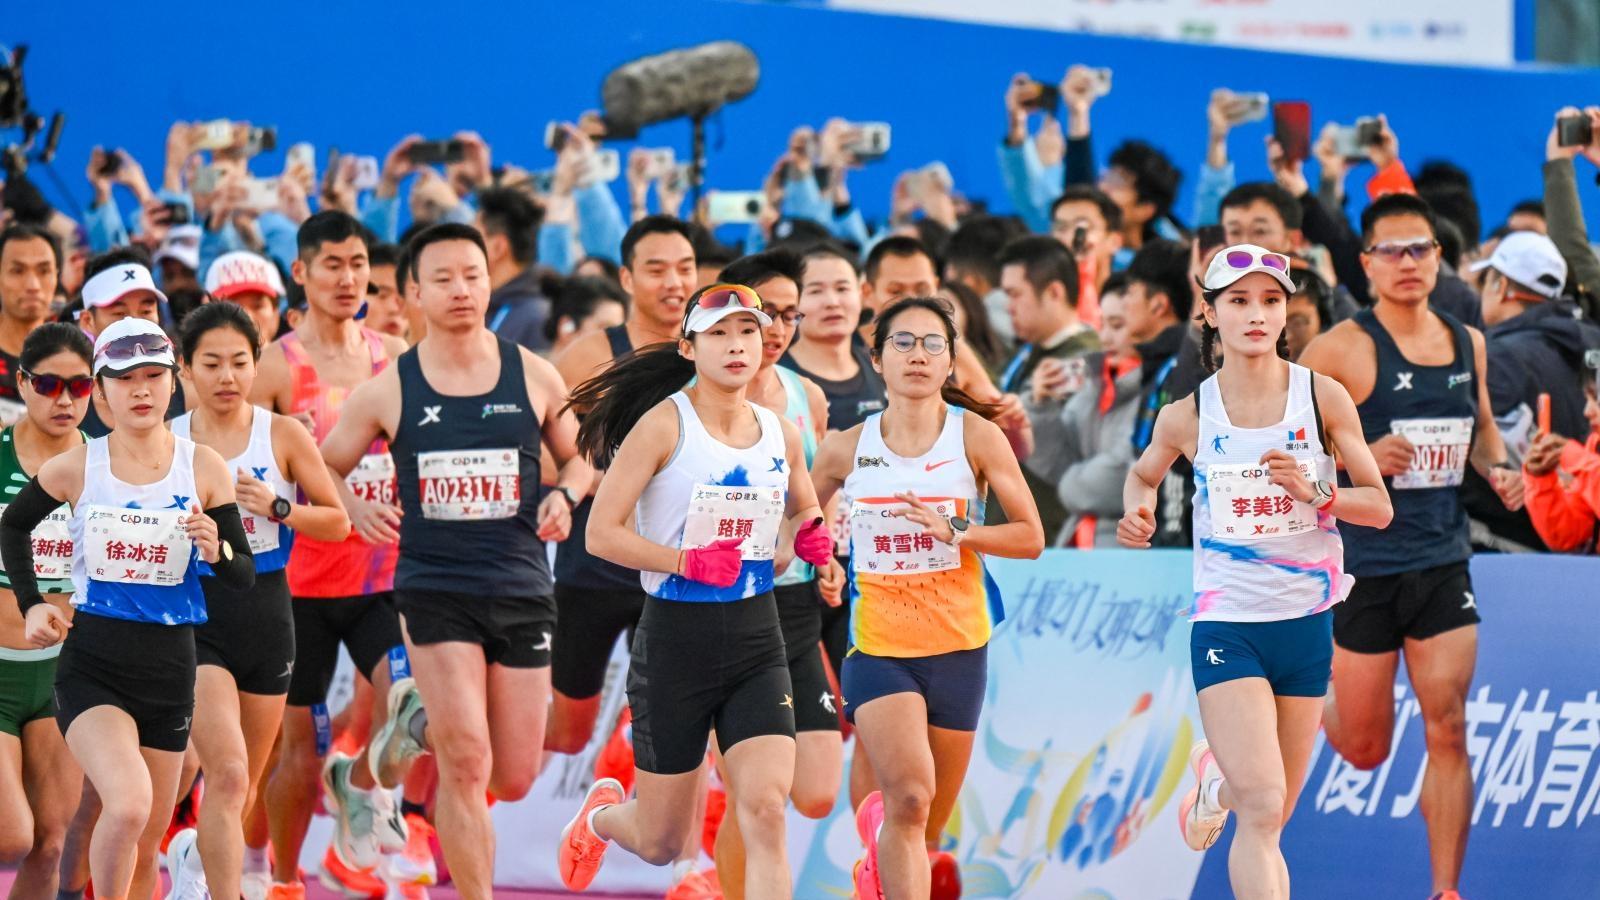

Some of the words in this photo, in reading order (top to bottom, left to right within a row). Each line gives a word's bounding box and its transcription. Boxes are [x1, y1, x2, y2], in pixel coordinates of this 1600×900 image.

[1231, 494, 1295, 518] 李美珍
[120, 514, 142, 525] C&D
[717, 518, 754, 538] 路颖
[106, 540, 169, 564] 徐冰洁
[873, 532, 934, 554] 黄雪梅
[96, 568, 104, 576] 62
[1297, 685, 1600, 829] 厦门市体育
